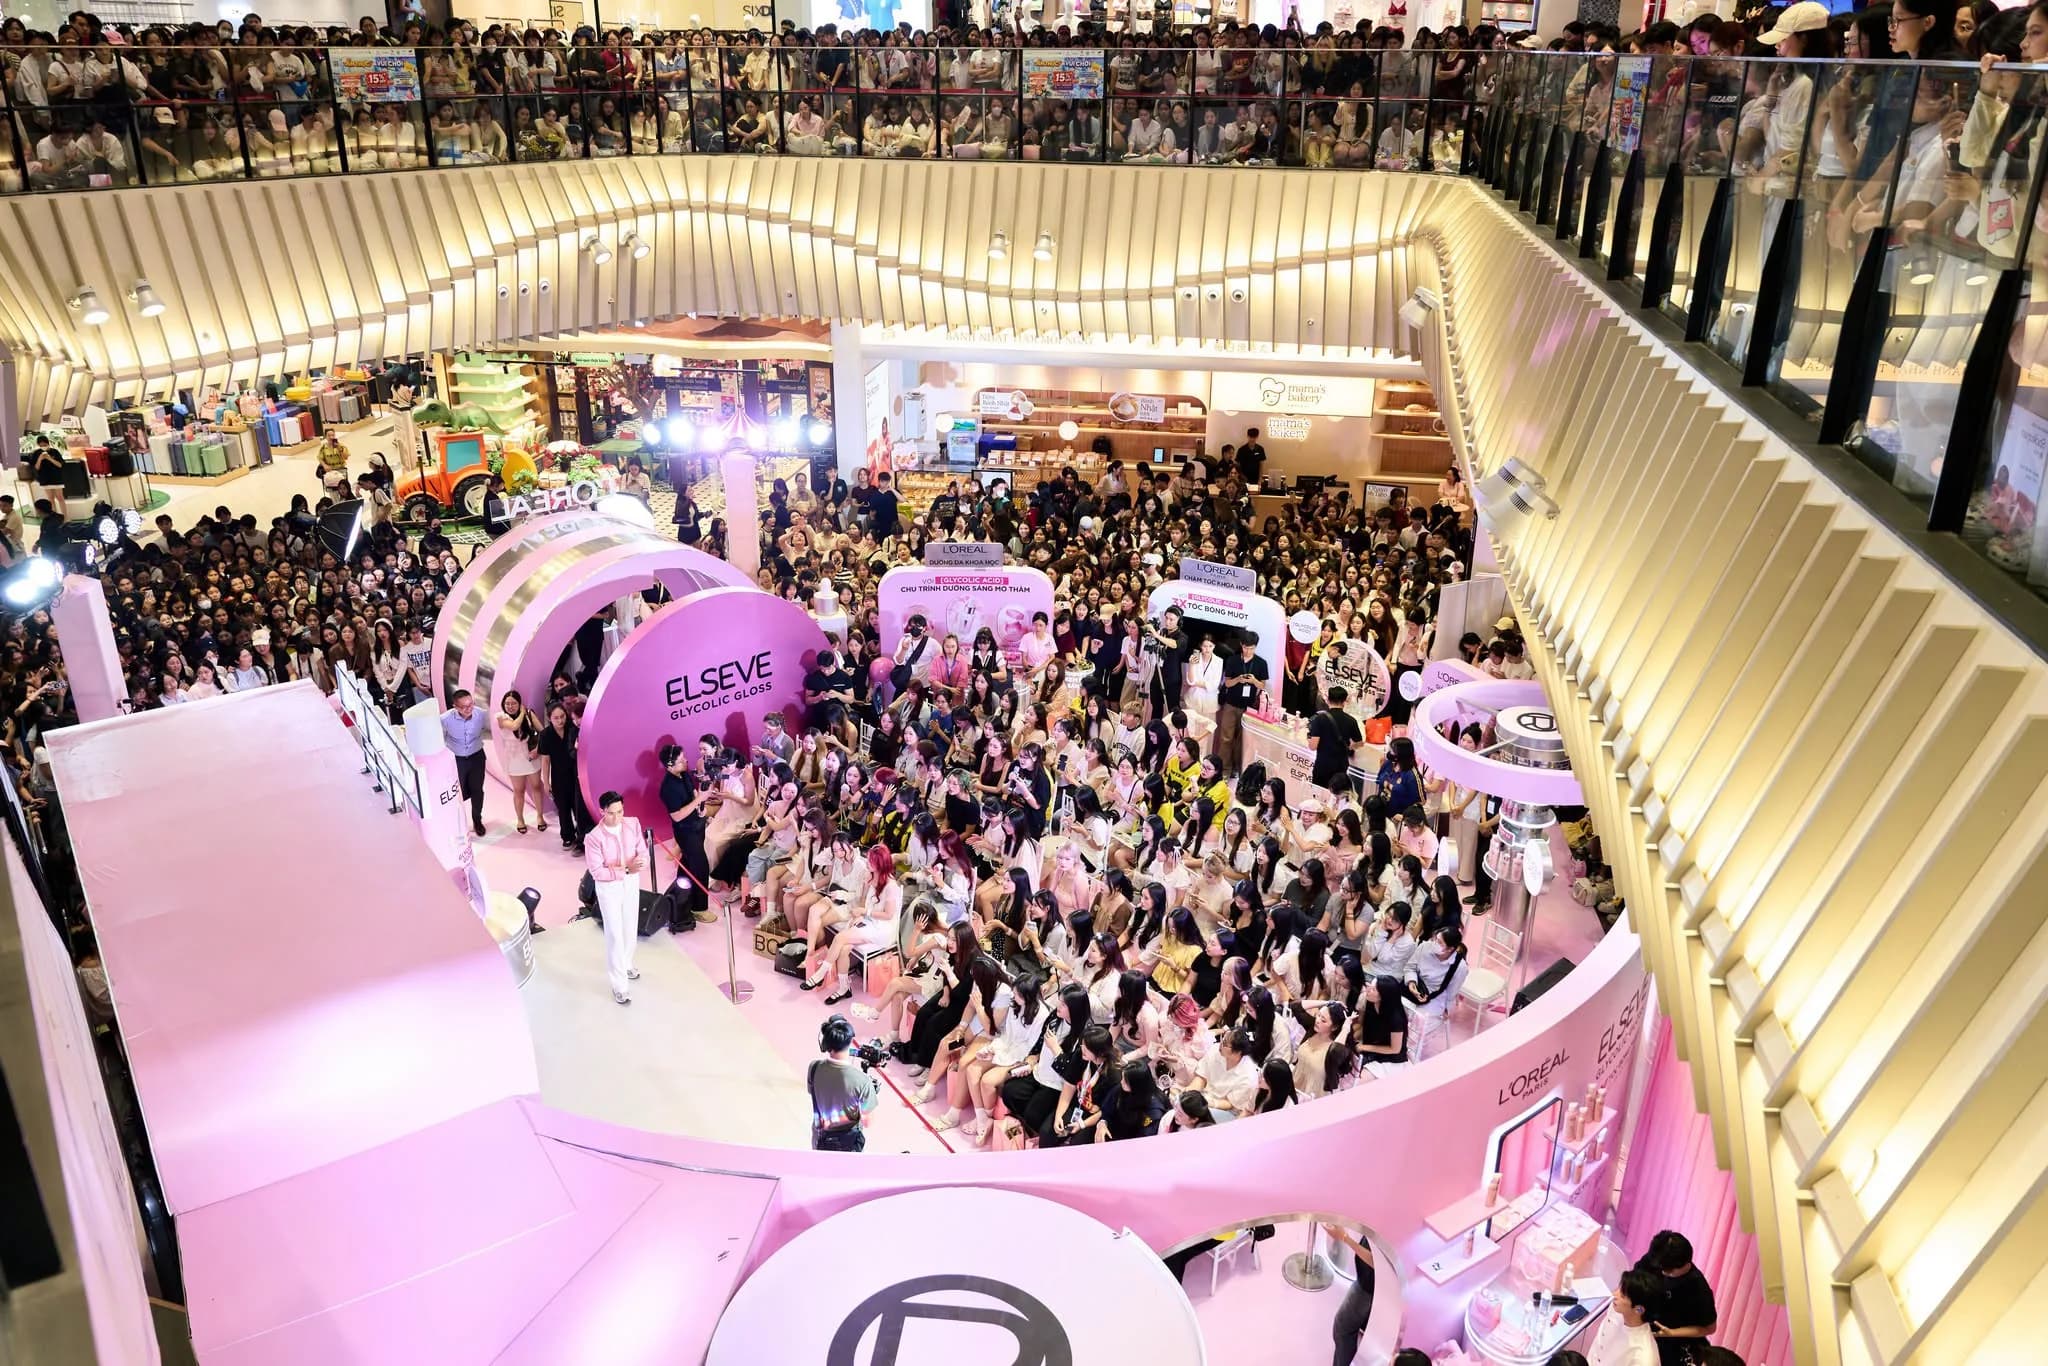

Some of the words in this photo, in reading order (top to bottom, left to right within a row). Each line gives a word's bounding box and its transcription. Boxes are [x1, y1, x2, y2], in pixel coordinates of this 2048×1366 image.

[743, 5, 772, 17] SIXD
[1288, 384, 1326, 394] mama's
[1288, 393, 1322, 405] bakery
[1268, 417, 1310, 428] mama's
[1270, 427, 1306, 440] bakery
[665, 650, 773, 707] ELSEVE
[1325, 659, 1378, 690] ELSEVE
[1325, 675, 1354, 689] GLYCOLIC
[670, 694, 730, 721] GLYCOLIC
[734, 681, 773, 701] GLOSS
[1522, 1077, 1549, 1100] PARIS
